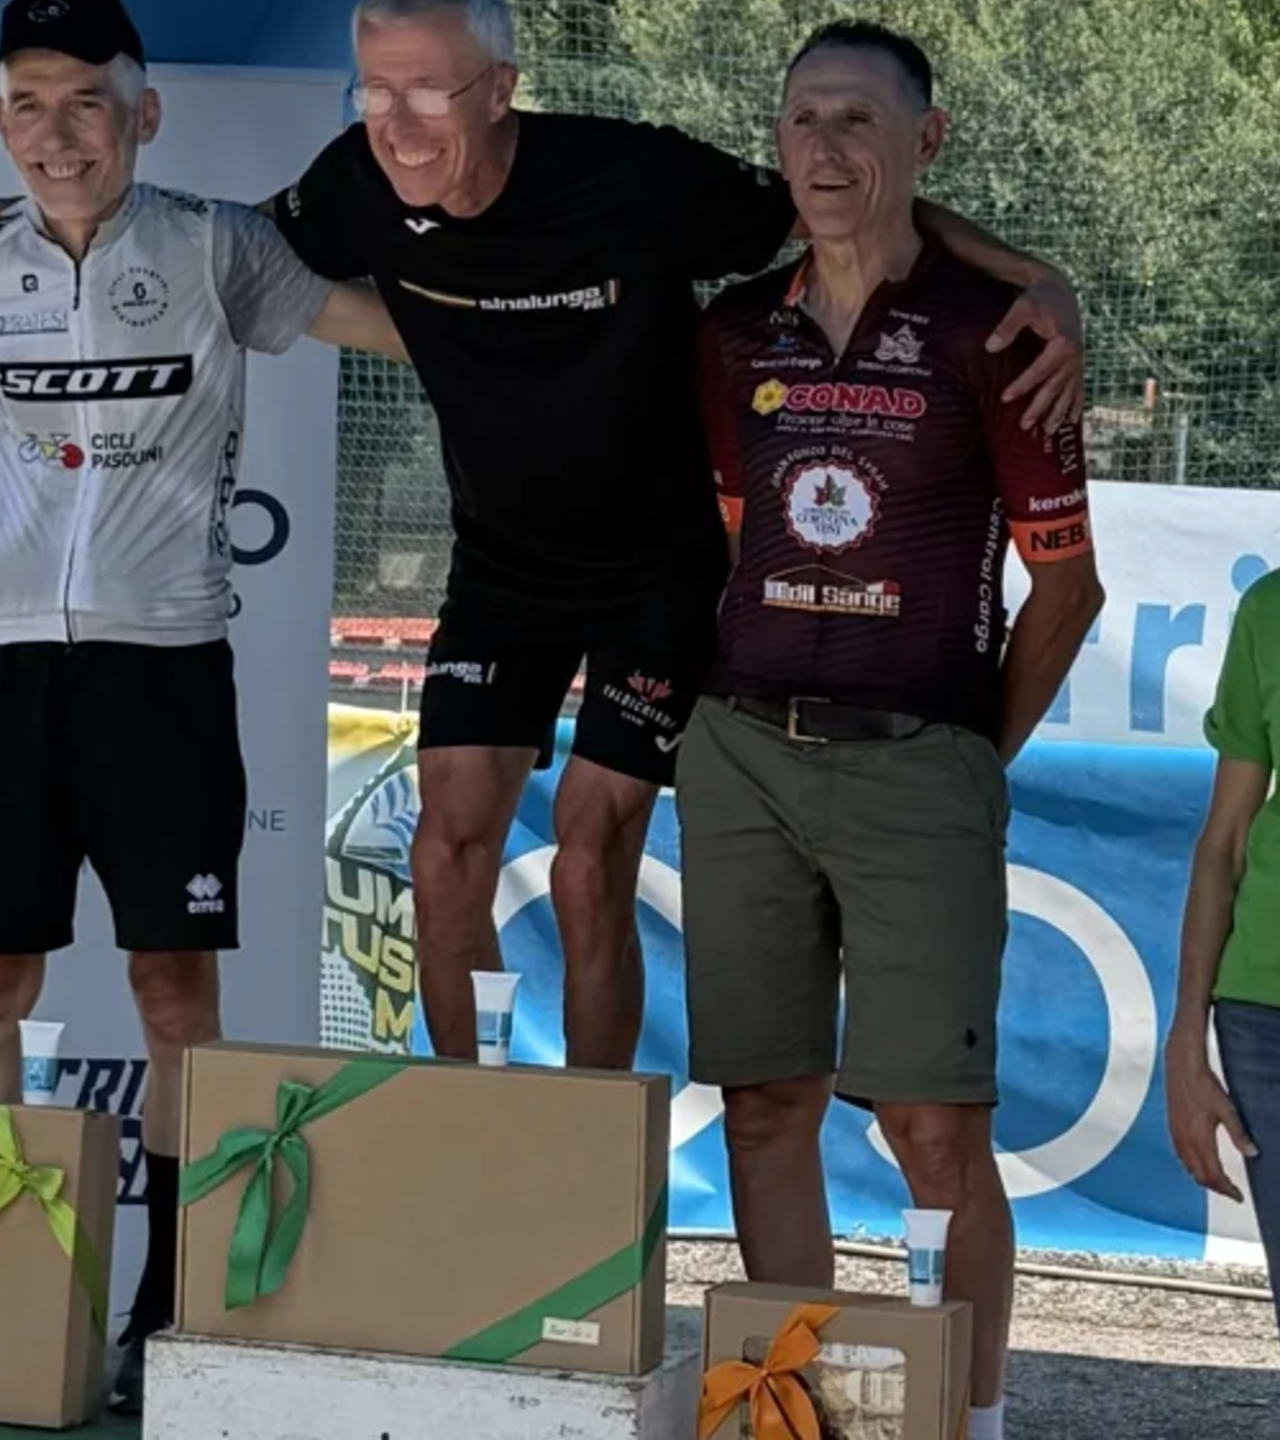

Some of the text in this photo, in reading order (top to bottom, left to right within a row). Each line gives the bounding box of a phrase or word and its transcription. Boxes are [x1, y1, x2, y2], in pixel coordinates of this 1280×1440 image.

[3, 362, 185, 394] SCOTT
[784, 382, 927, 420] CONAD
[974, 583, 993, 653] Cargo
